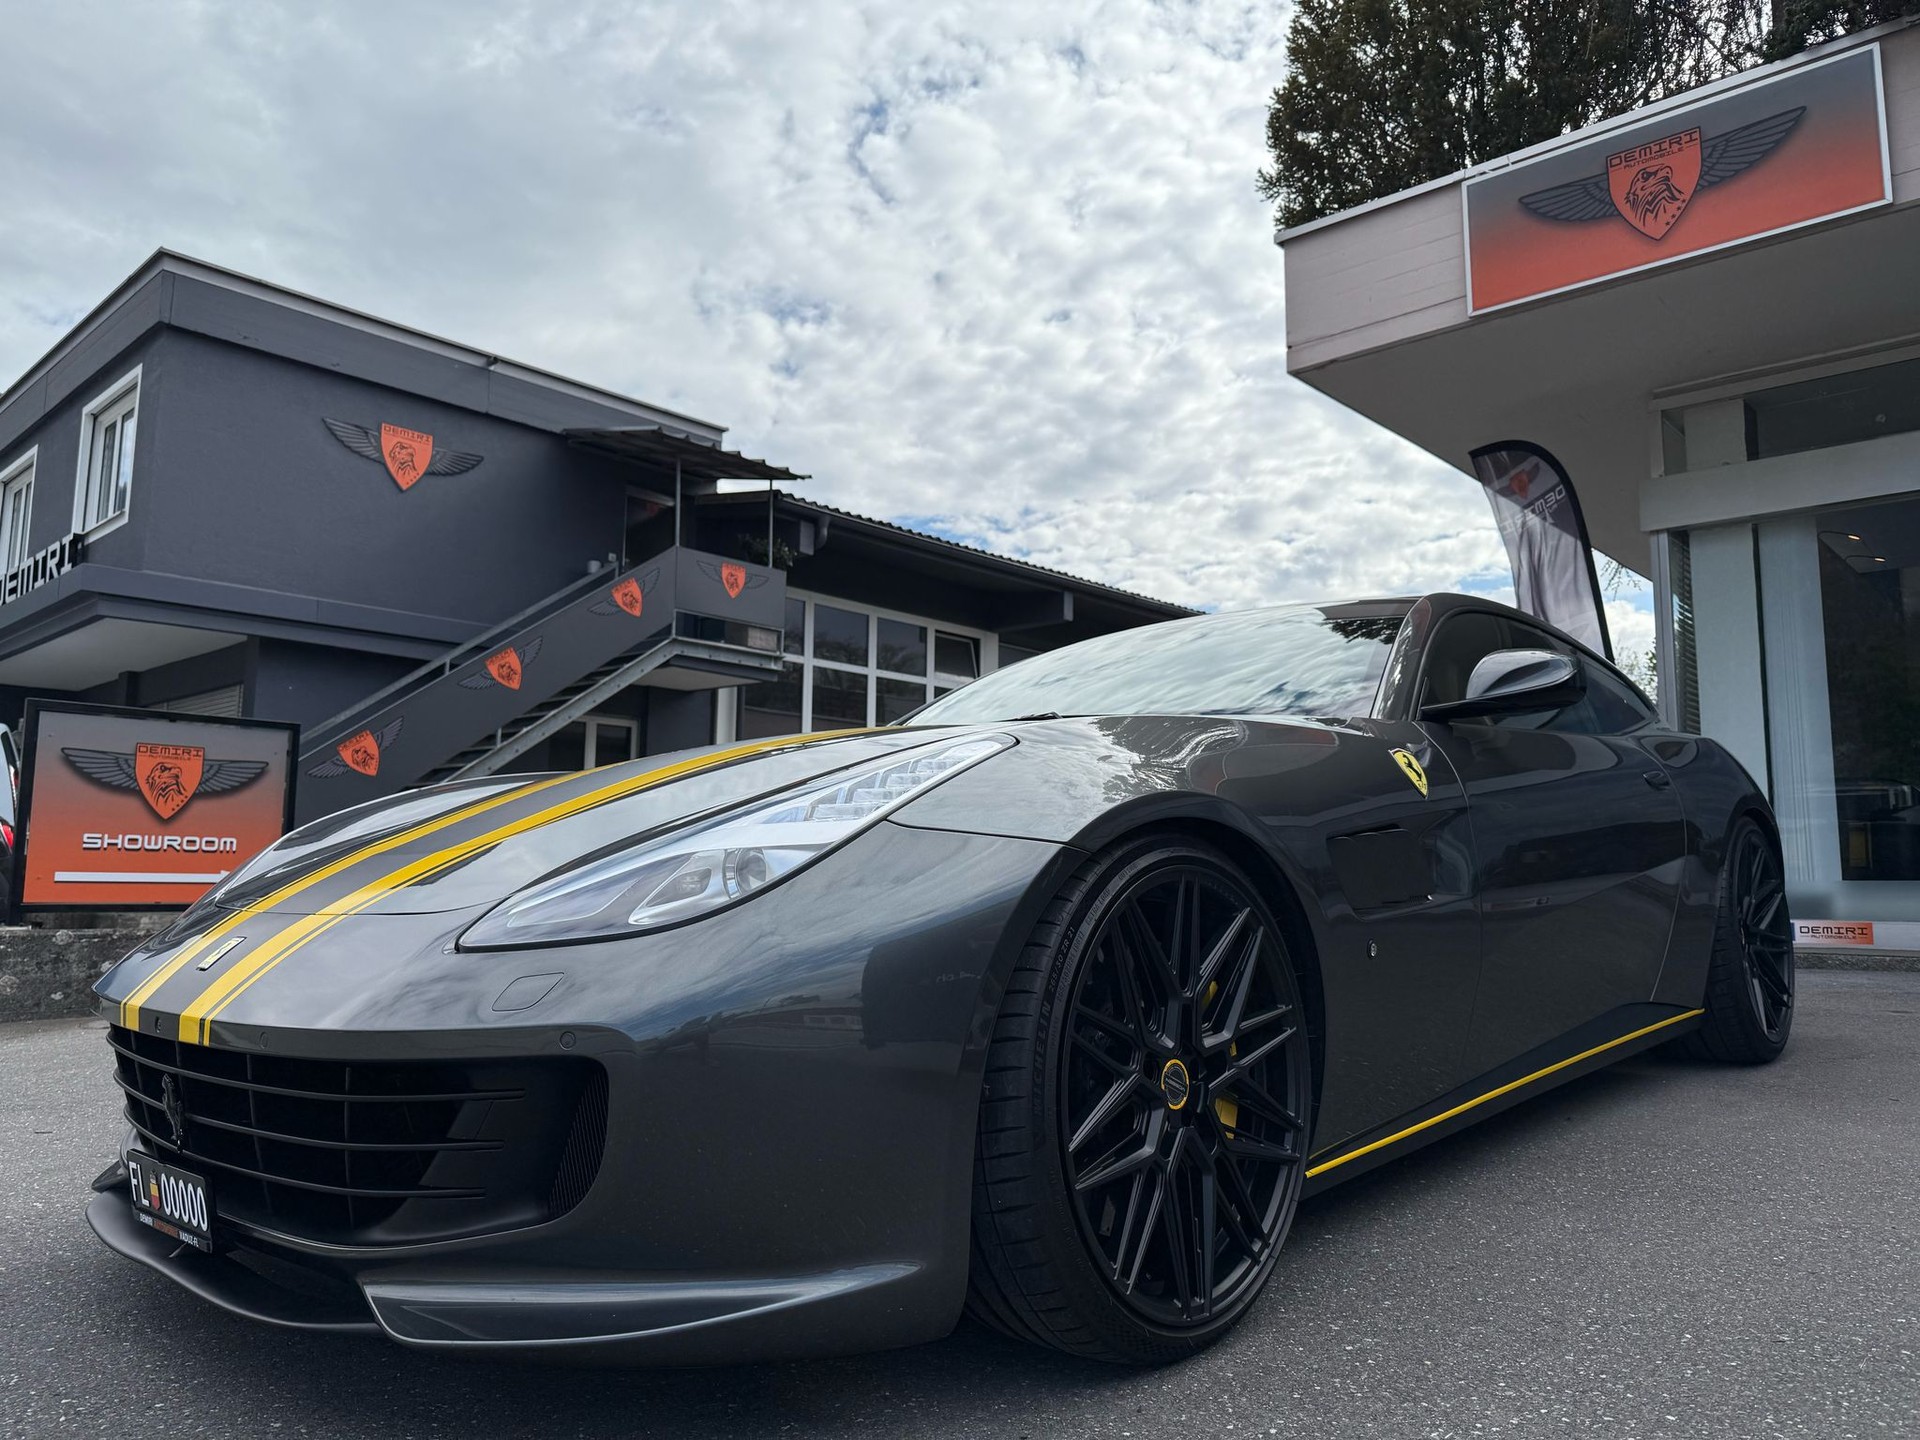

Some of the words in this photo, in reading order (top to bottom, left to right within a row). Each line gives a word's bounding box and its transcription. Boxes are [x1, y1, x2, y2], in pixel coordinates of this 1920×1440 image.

[1609, 130, 1699, 168] DEMIRI
[1623, 147, 1685, 169] AUTOMOBILE
[138, 745, 202, 757] DEMIRI
[82, 833, 237, 853] SHOWROOM
[1800, 926, 1867, 935] DEMIRI
[129, 1161, 150, 1207] FL
[161, 1173, 207, 1232] 00000
